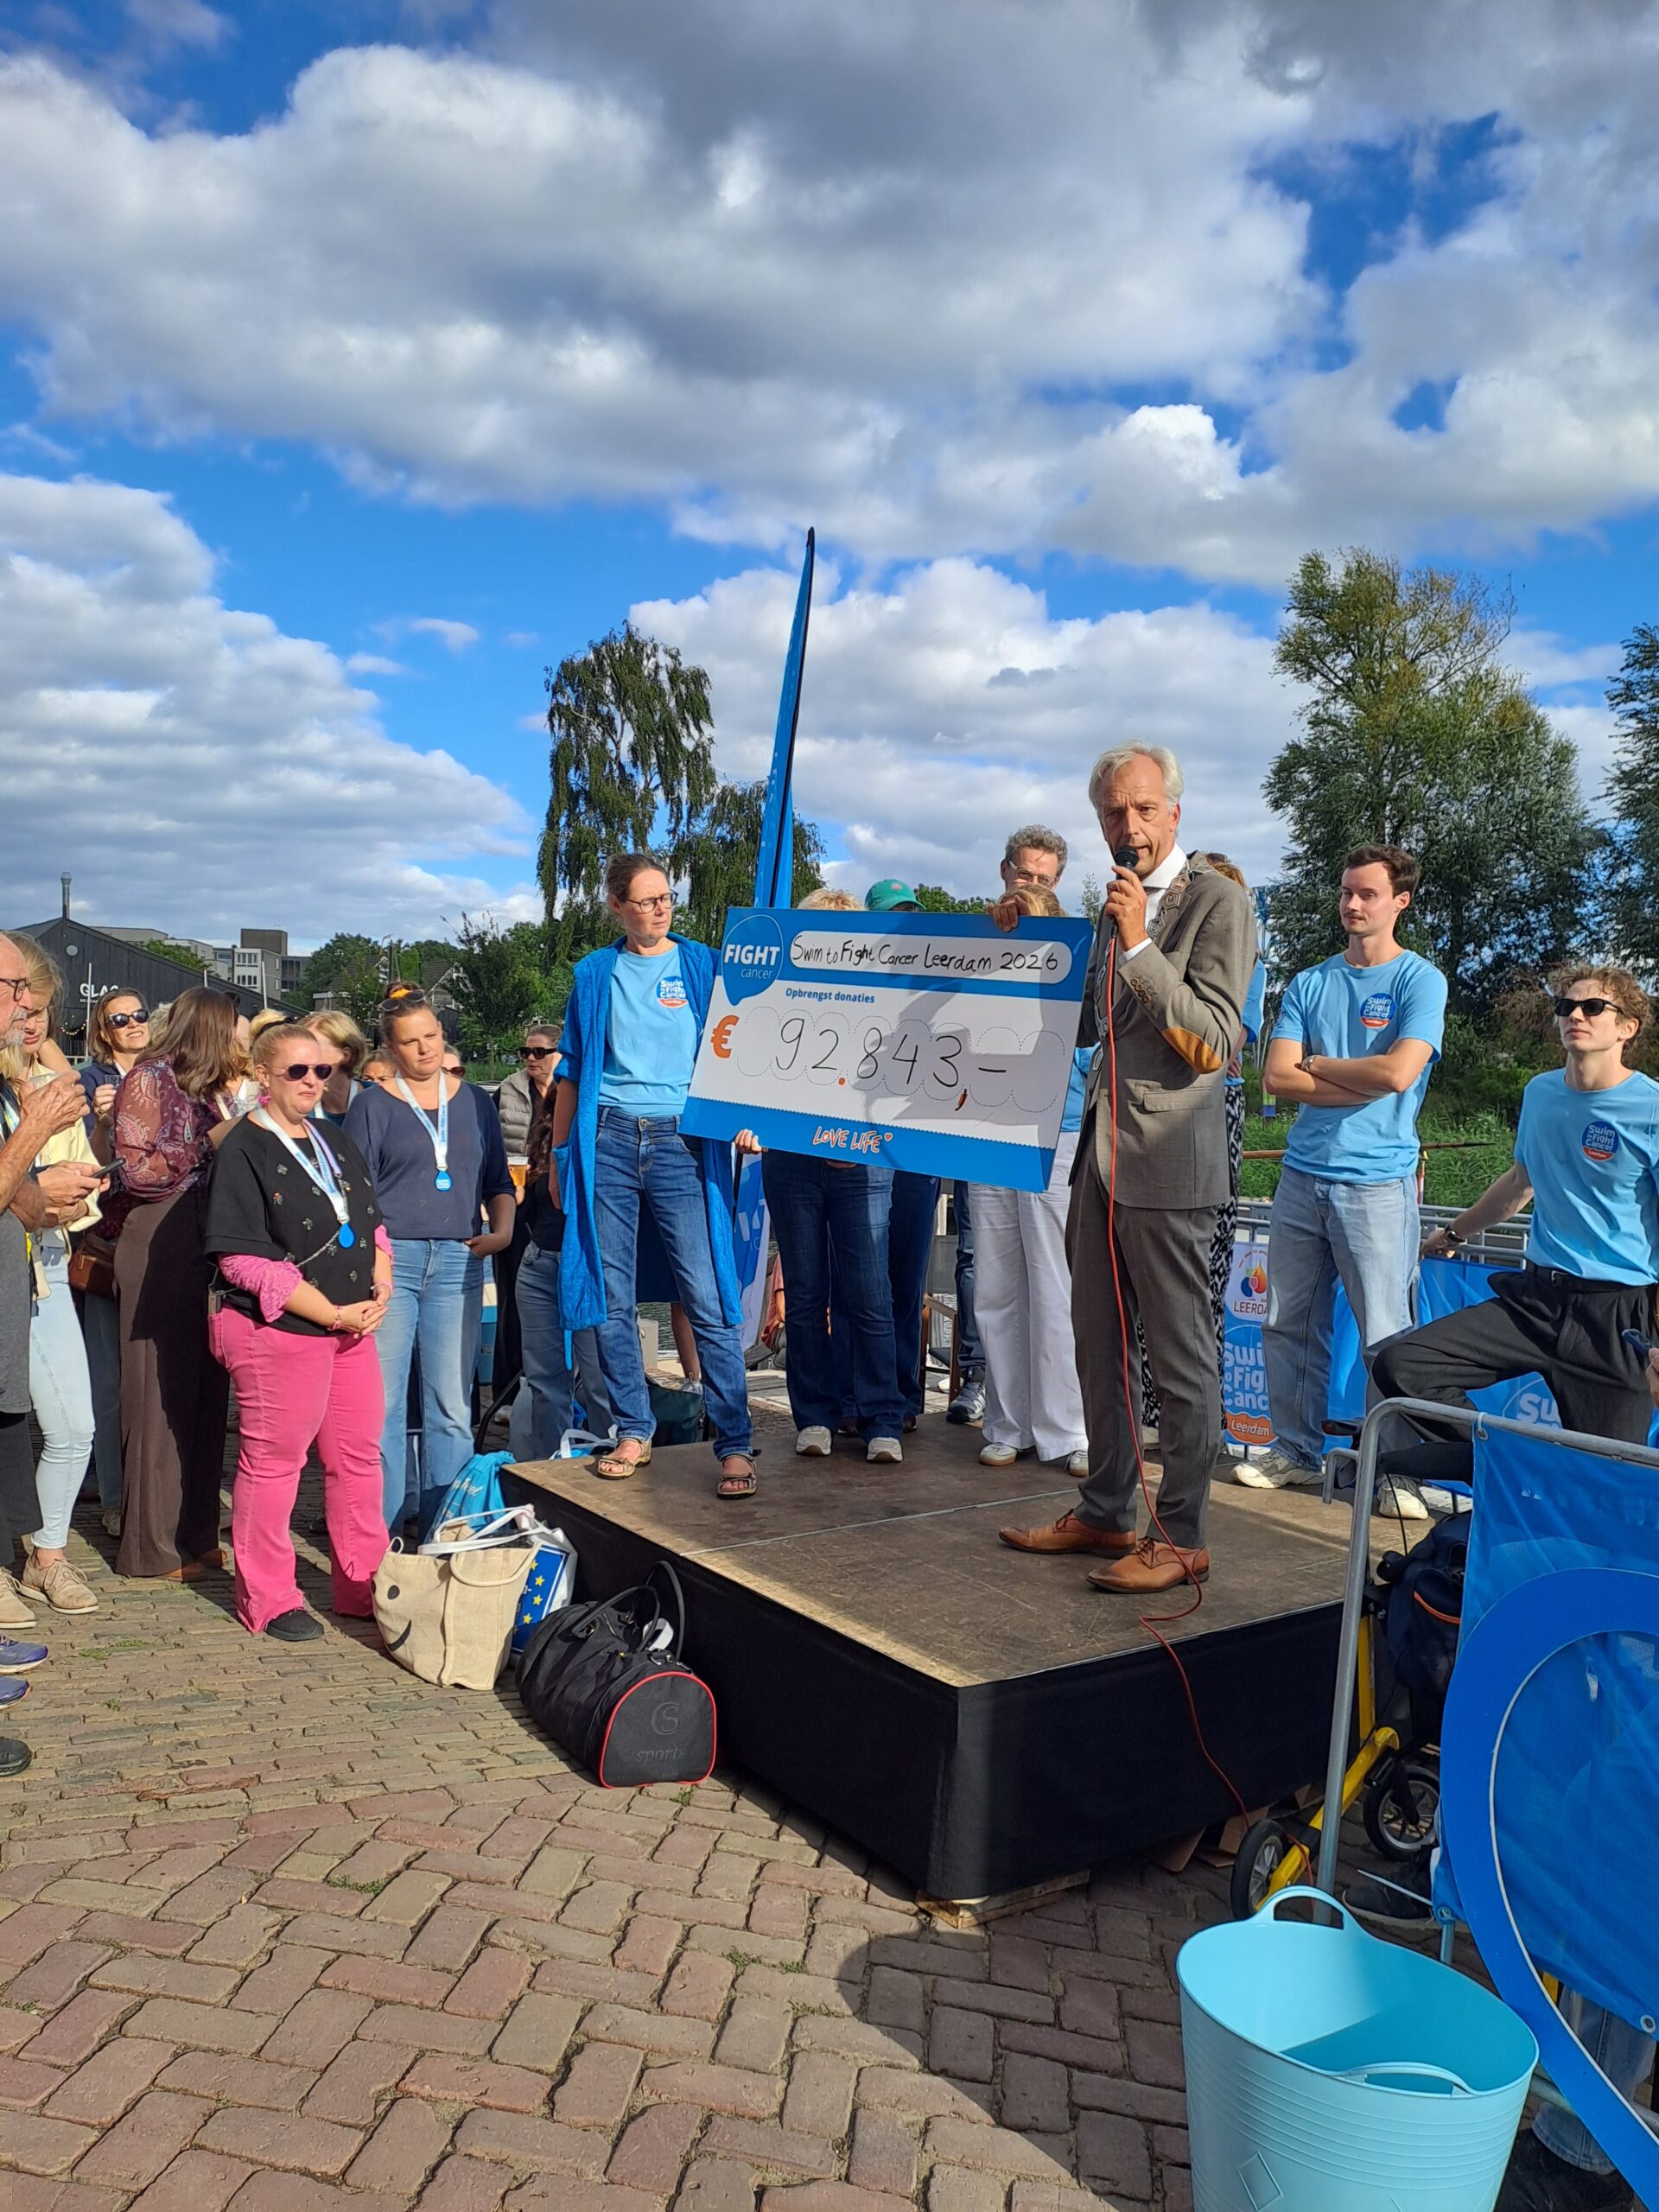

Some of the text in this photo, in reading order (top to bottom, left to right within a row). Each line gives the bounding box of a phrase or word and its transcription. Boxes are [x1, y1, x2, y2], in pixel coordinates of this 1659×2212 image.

[723, 943, 780, 967] FIGHT
[792, 935, 1058, 972] Swim to Fight Cancer Leerdam 2026
[741, 967, 773, 980] cancer
[785, 987, 875, 1004] Opbrengst donaties
[1367, 996, 1392, 1006] Swim
[1363, 1008, 1390, 1019] Cancer
[1370, 1002, 1391, 1013] Fight
[710, 1014, 741, 1059] €
[1588, 1124, 1616, 1137] Swim
[813, 1126, 882, 1154] LOVE LIFE
[1586, 1138, 1614, 1151] Cancer
[1231, 1419, 1269, 1436] Leerdam
